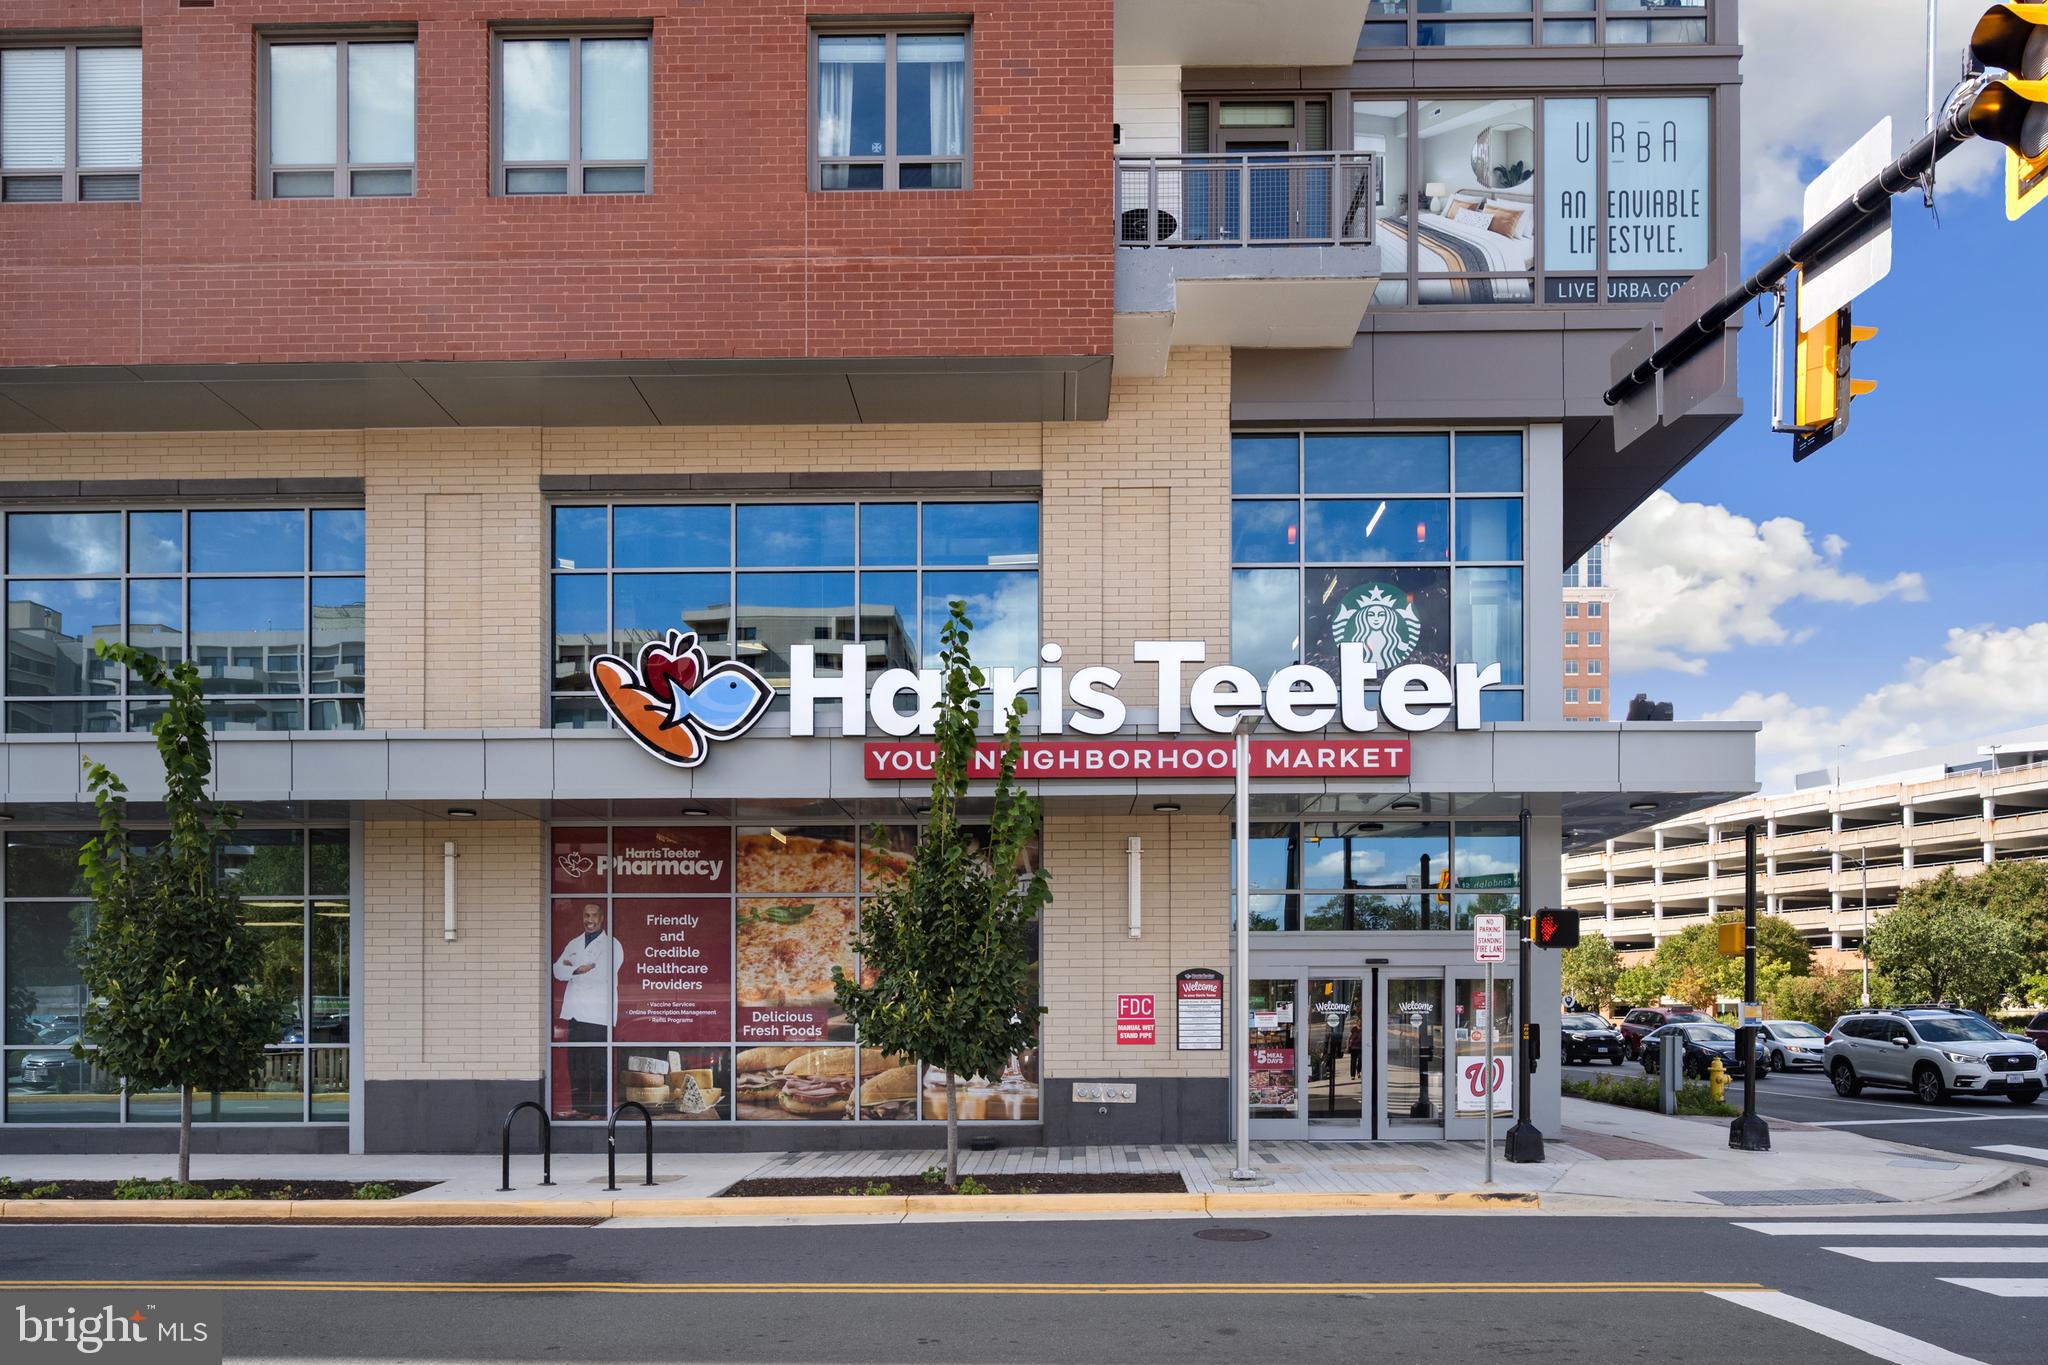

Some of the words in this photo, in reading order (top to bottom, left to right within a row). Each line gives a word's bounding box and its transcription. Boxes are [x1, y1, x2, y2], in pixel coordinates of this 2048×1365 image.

[1576, 121, 1677, 163] URBA
[1561, 190, 1586, 219] AN
[1608, 189, 1699, 218] ENVIABLE
[1570, 225, 1682, 253] LIFESTYLE.
[1134, 640, 1501, 734] Teeter
[872, 750, 950, 771] YOU
[975, 748, 1251, 771] NIGHBORHOO
[1266, 747, 1403, 768] MARKET
[625, 847, 661, 858] Harris
[662, 847, 700, 858] Teeter
[597, 855, 723, 880] Pharmacy
[646, 914, 699, 928] Friendly
[660, 931, 684, 941] and
[645, 946, 700, 958] Credible
[1477, 945, 1488, 953] FIRE
[1489, 945, 1503, 953] LANE
[637, 962, 708, 974] Healthcare
[642, 979, 702, 990] Providers
[1182, 981, 1217, 993] Welcome
[1120, 998, 1152, 1016] FDC
[1315, 1000, 1350, 1012] Welcome
[1398, 1000, 1434, 1012] Welcome
[752, 1011, 813, 1023] Delicious
[743, 1025, 778, 1036] Fresh
[783, 1025, 822, 1036] Foods
[1254, 1050, 1267, 1064] $5
